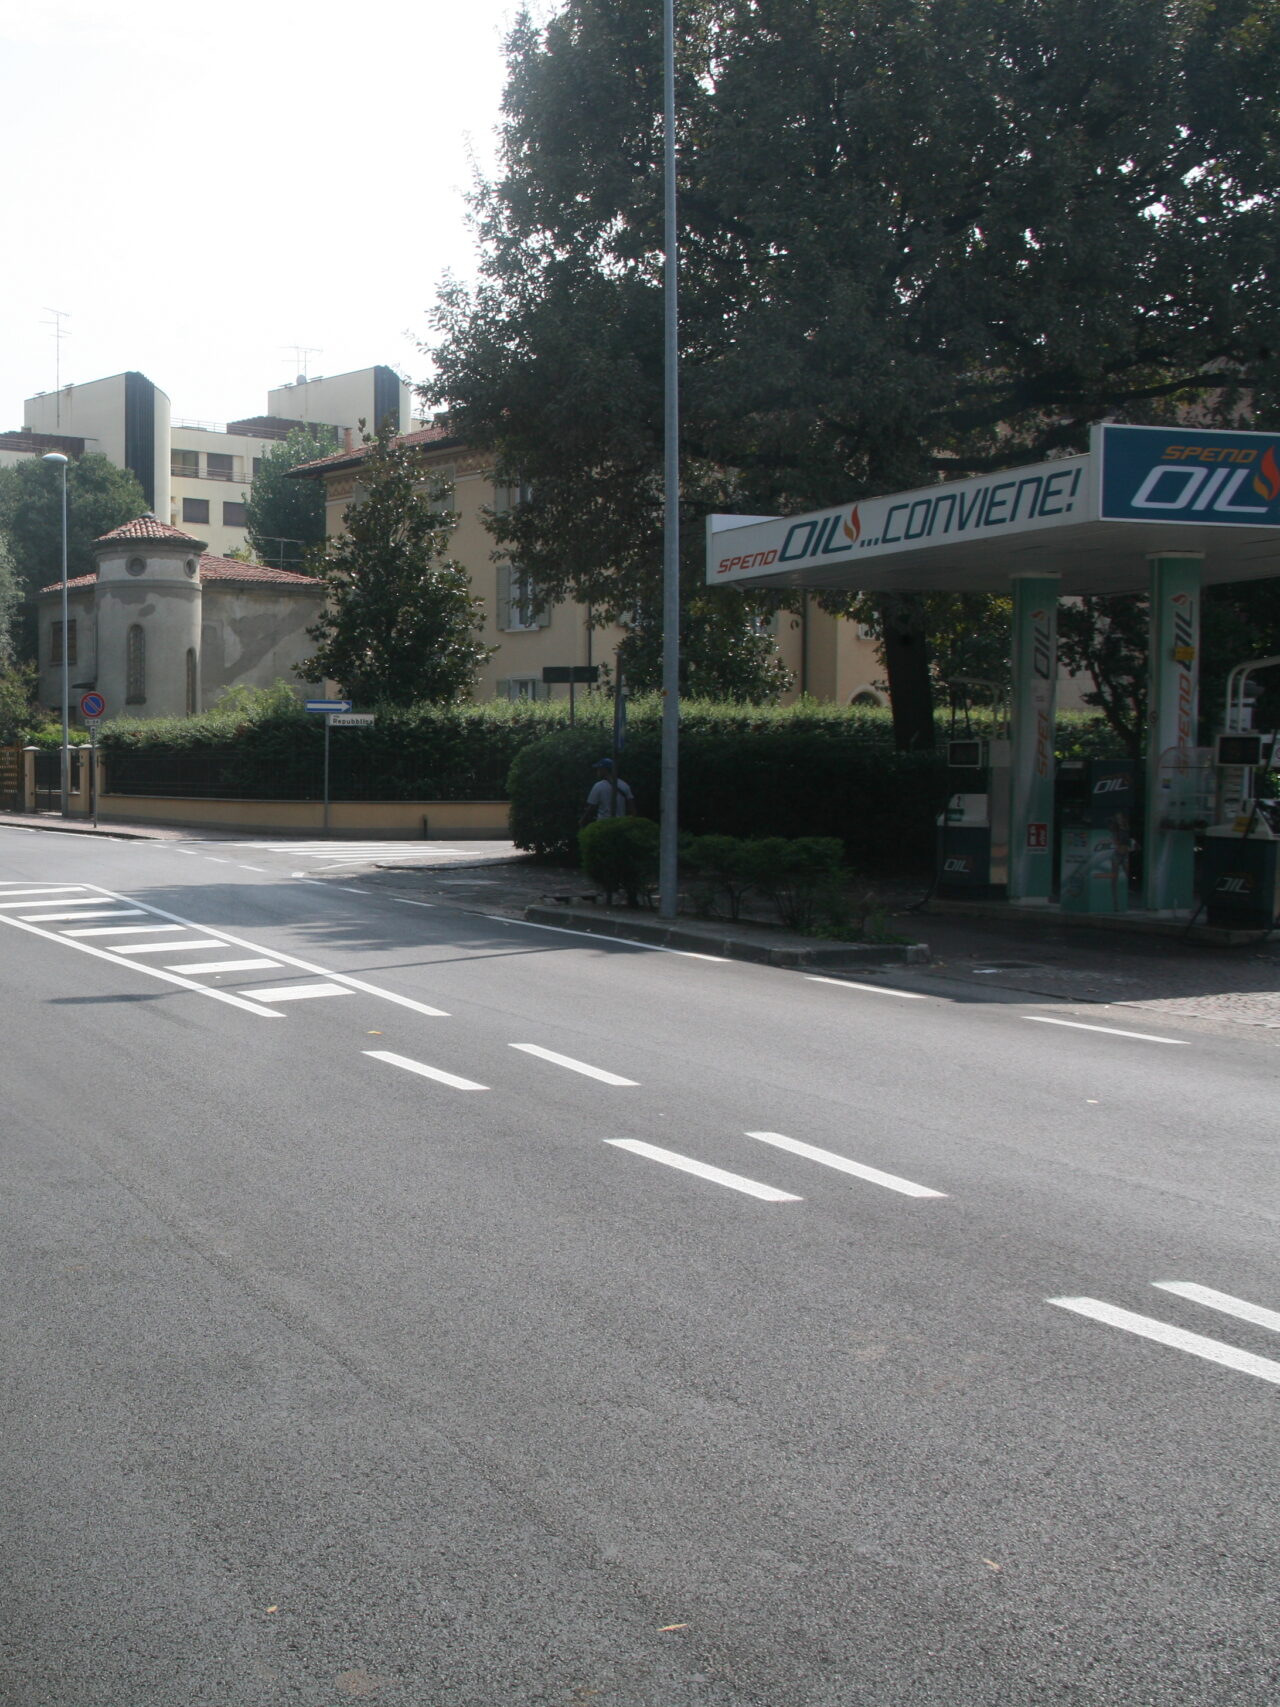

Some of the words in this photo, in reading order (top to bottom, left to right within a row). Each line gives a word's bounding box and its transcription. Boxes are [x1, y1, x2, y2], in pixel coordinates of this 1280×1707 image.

[1161, 446, 1259, 463] SPEND
[1131, 465, 1269, 513] OIL
[716, 549, 778, 574] SPEND
[778, 515, 853, 562] OIL
[1034, 616, 1051, 680] OIL
[1036, 708, 1050, 777] SPE
[1094, 778, 1129, 794] OIL
[944, 859, 971, 872] OIL
